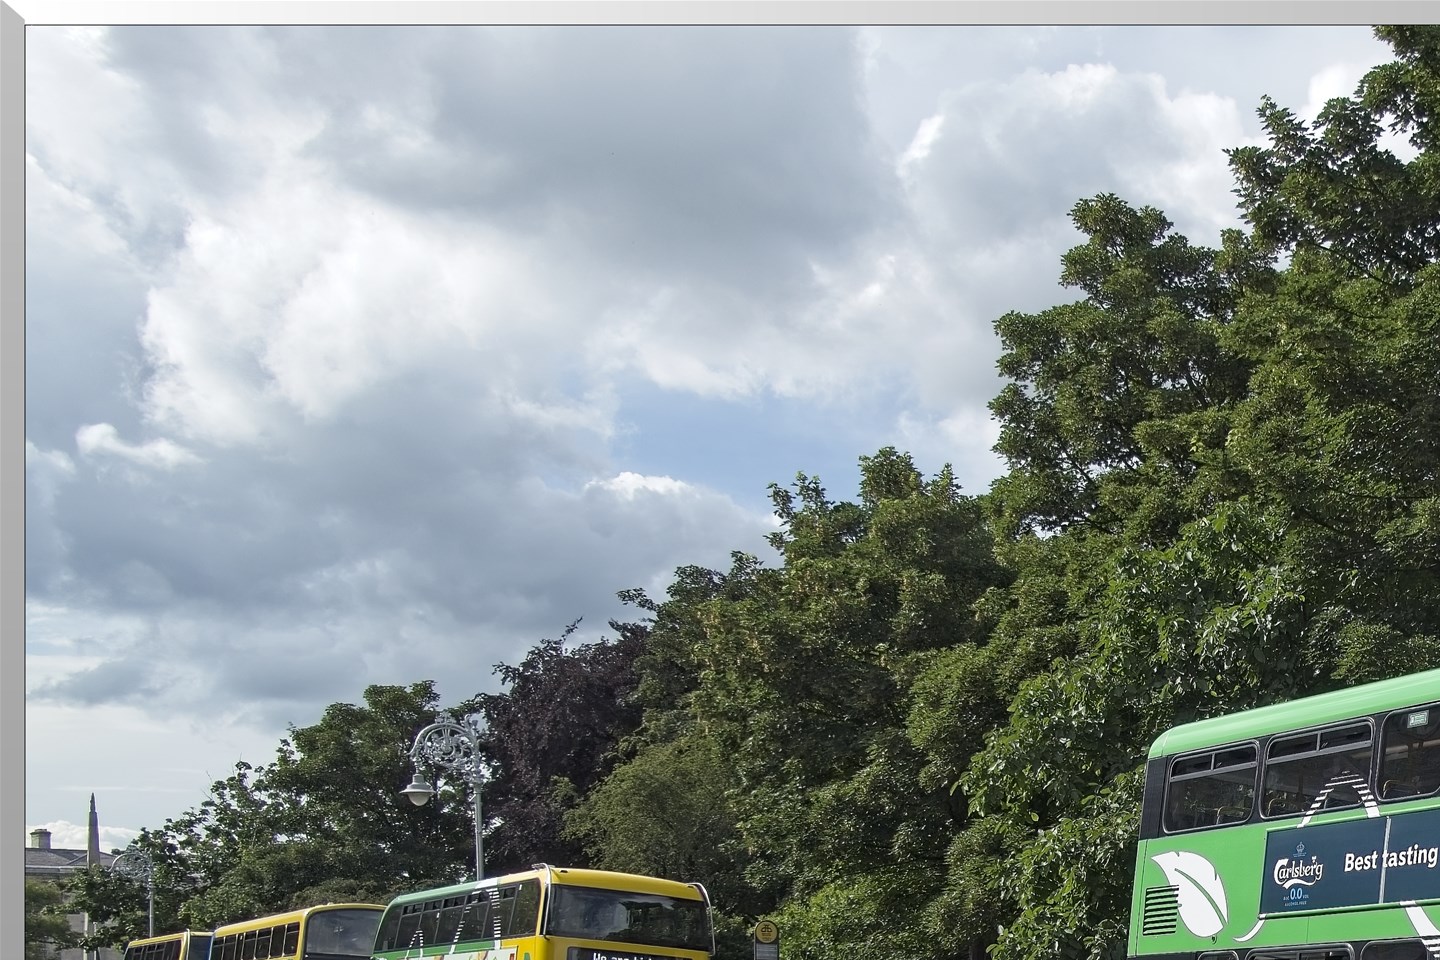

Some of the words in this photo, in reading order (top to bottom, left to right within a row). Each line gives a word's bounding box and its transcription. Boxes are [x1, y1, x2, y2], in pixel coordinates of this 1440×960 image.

[1273, 856, 1324, 885] Carlsberg
[1344, 852, 1377, 872] Best
[1382, 844, 1438, 868] tasting
[1290, 887, 1303, 900] 0.0
